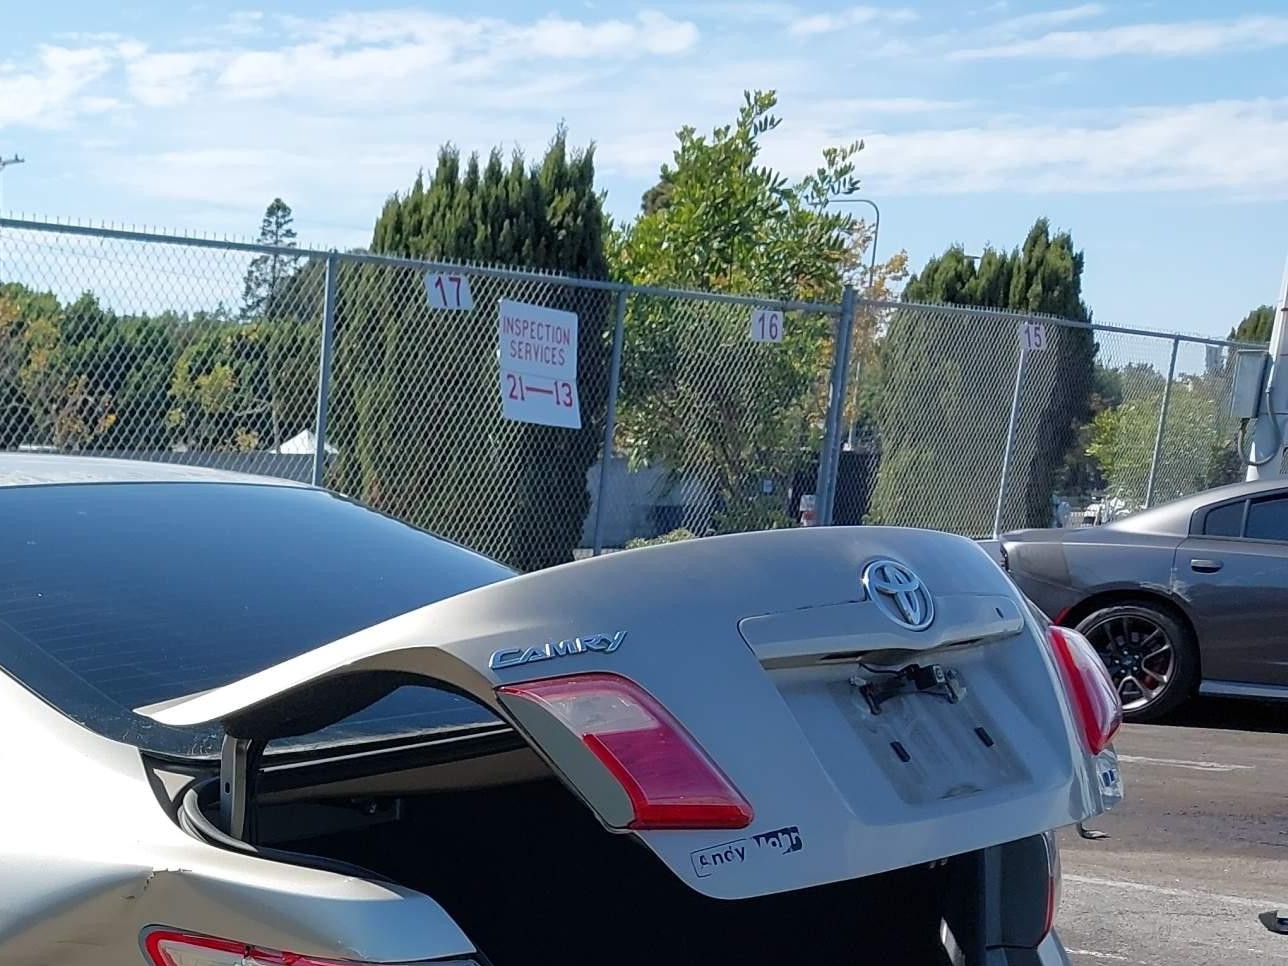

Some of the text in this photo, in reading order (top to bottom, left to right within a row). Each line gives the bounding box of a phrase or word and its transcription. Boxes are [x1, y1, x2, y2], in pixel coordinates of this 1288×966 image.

[434, 276, 461, 306] 17
[503, 316, 570, 345] INSPECTION
[758, 312, 778, 340] 16
[1024, 326, 1042, 348] 15
[509, 340, 565, 366] SERVICES
[488, 630, 628, 669] CAMRY
